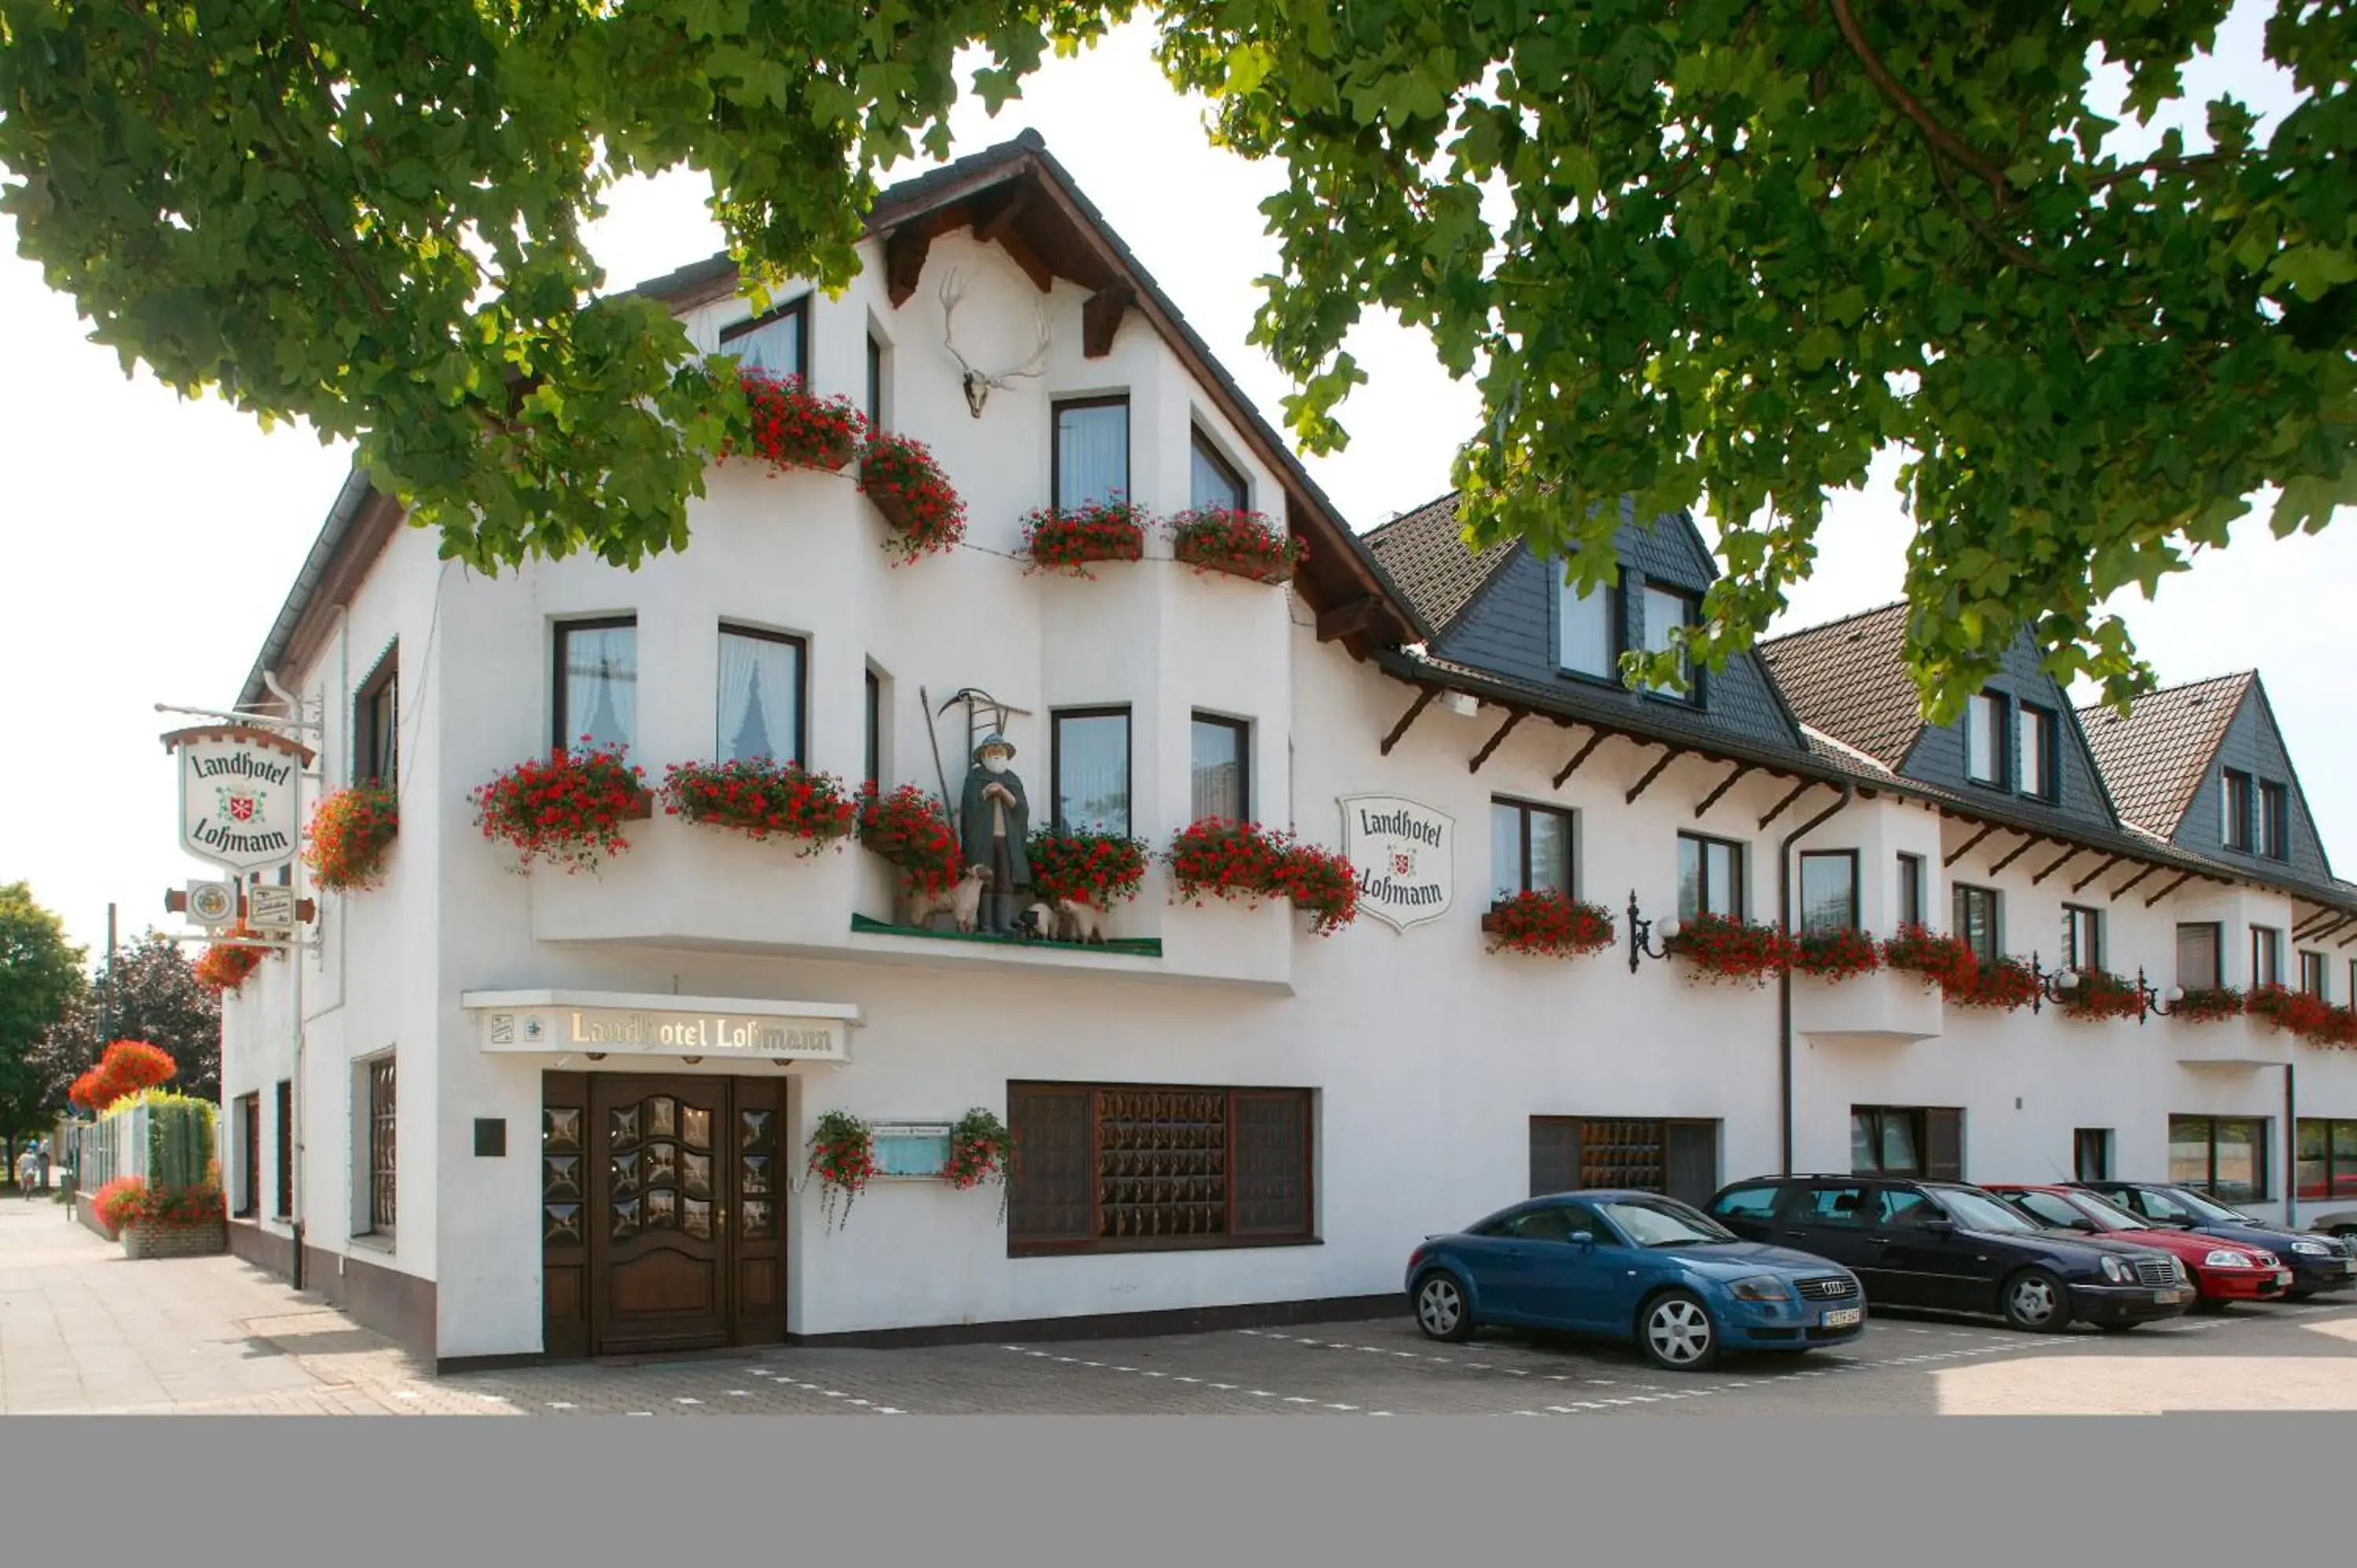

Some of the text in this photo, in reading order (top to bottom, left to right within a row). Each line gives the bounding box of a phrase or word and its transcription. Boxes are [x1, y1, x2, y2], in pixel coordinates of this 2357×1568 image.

[192, 752, 290, 786] Landhotel
[192, 818, 288, 852] Lohmann
[1360, 808, 1442, 848] Landhotel
[1362, 867, 1442, 905] Lohmann
[572, 1012, 833, 1053] Landhotel Lohmann
